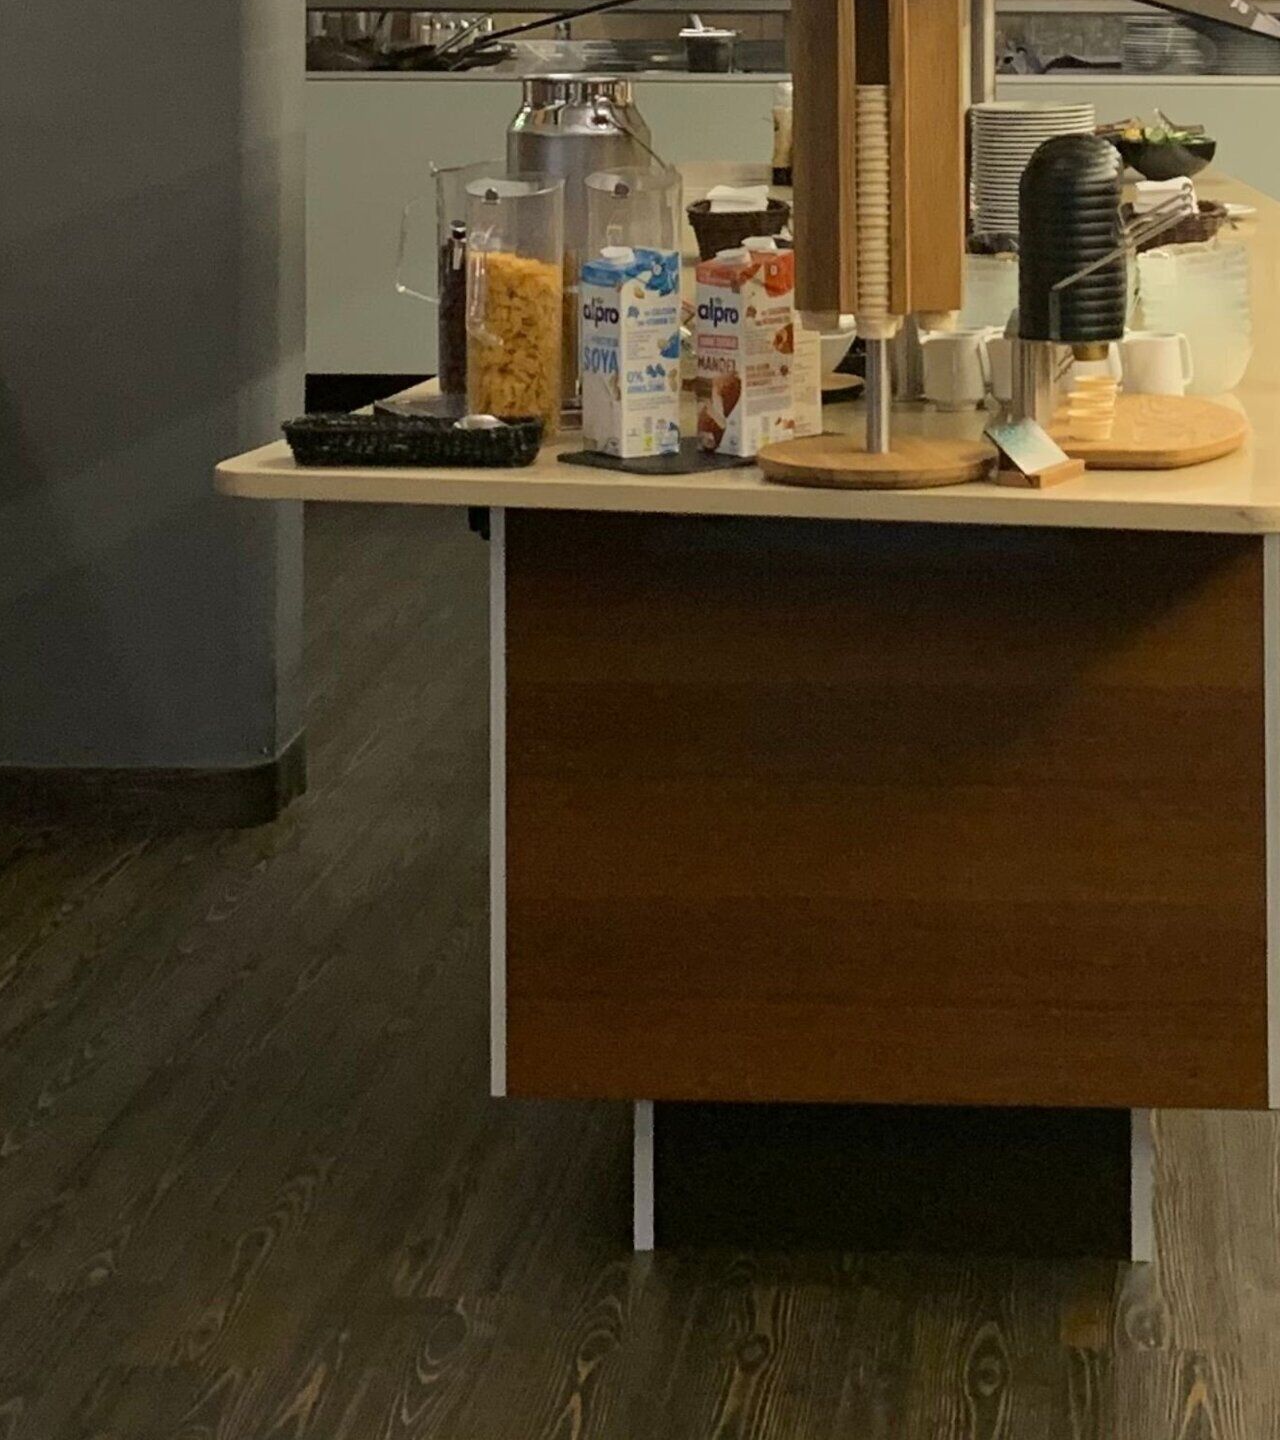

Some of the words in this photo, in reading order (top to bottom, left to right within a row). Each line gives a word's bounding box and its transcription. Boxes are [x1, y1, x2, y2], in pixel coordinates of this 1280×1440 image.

[583, 296, 620, 328] alpro
[698, 297, 740, 327] alpro
[584, 347, 619, 374] SOYA
